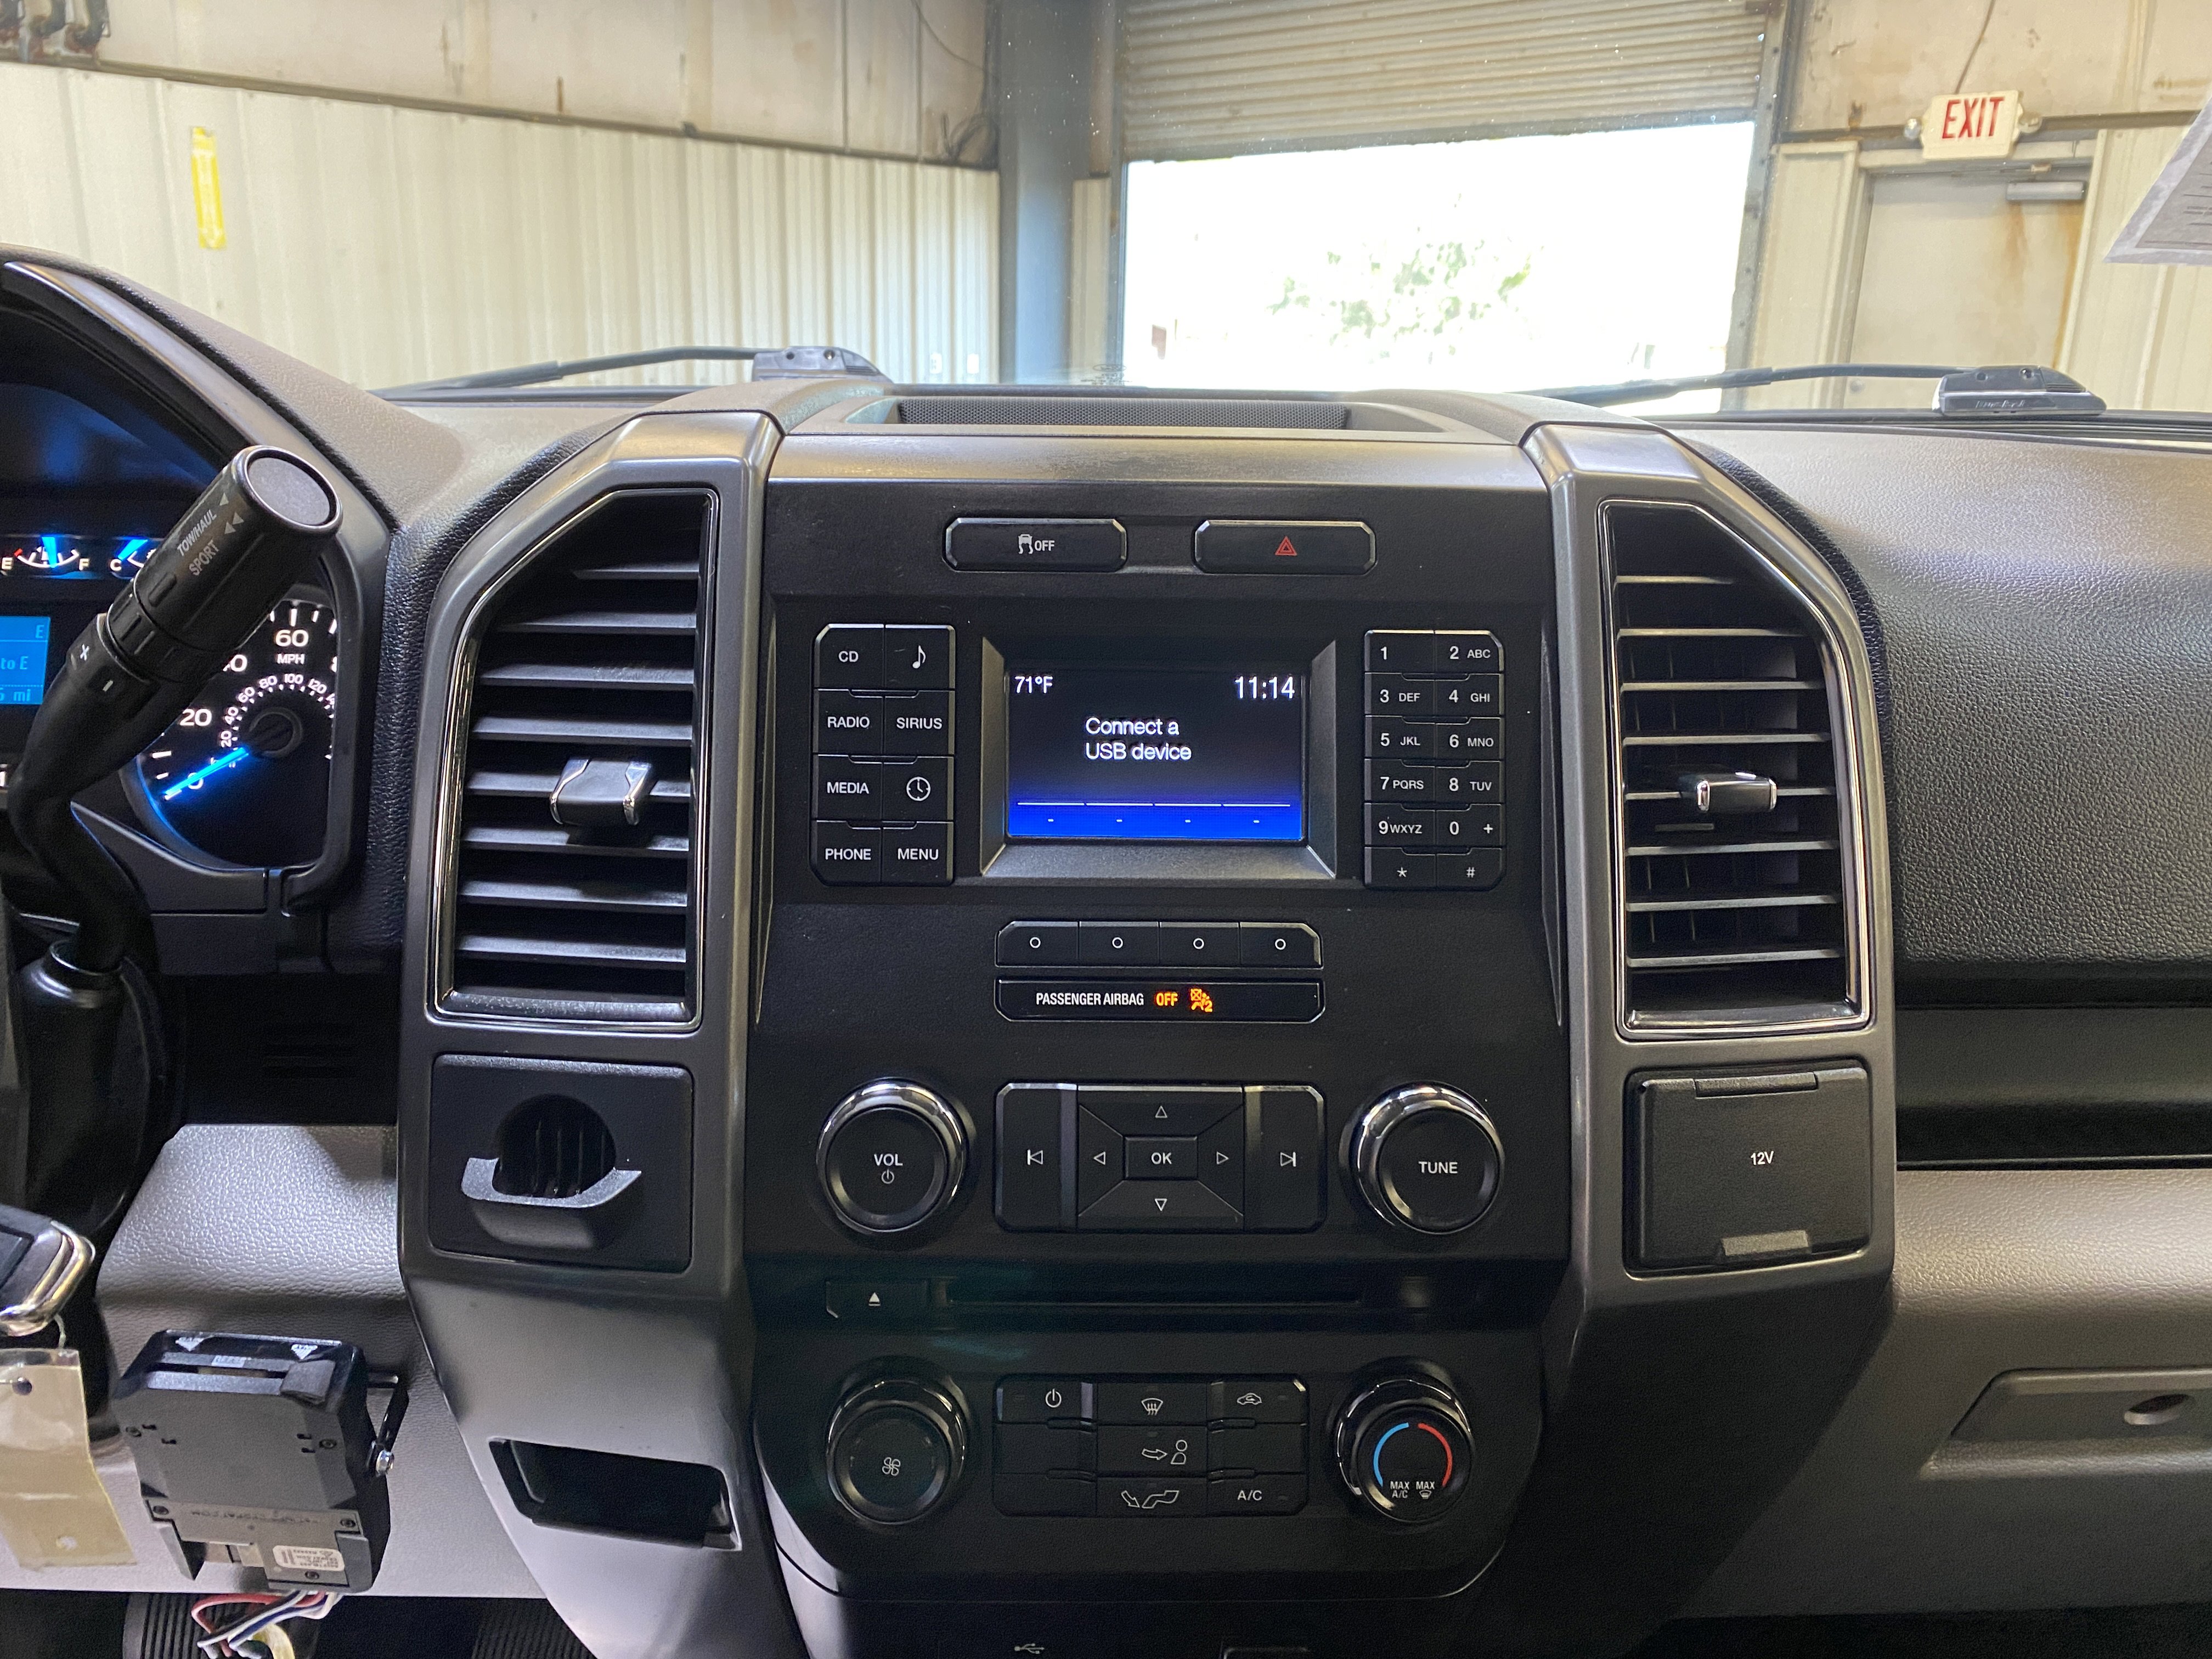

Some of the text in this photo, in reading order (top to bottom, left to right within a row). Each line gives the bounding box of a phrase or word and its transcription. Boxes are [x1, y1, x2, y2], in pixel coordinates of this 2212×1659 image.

[1942, 96, 2005, 139] EXIT
[1034, 540, 1055, 551] OFF
[1, 557, 13, 570] E
[189, 539, 219, 575] SPORT
[78, 558, 89, 571] F
[110, 558, 122, 571] C
[35, 624, 45, 638] E
[275, 629, 309, 647] 60
[277, 654, 305, 665] MPH
[838, 651, 859, 663] CD
[1380, 646, 1387, 660] 1
[1449, 646, 1491, 659] 2 ABC
[20, 656, 28, 669] E
[223, 654, 247, 672] 0
[258, 676, 278, 689] 80
[284, 674, 304, 685] 100
[1014, 675, 1053, 693] 71°F
[308, 679, 327, 695] 120
[1235, 676, 1295, 699] 11:14
[13, 689, 31, 701] mi
[238, 687, 256, 703] 60
[1380, 689, 1421, 703] 3 DEF
[1448, 689, 1490, 703] 4 GHI
[179, 708, 212, 726] 20
[224, 707, 239, 725] 40
[827, 716, 870, 728] RADIO
[896, 717, 943, 730] SIRIUS
[1085, 717, 1180, 735] Connect a
[221, 730, 232, 748] 20
[1380, 732, 1421, 747] 5 JKL
[1449, 734, 1494, 748] 6 MNO
[1086, 742, 1192, 760] USB device
[827, 782, 870, 794] MEDIA
[1380, 776, 1424, 790] 7 PQRS
[1449, 777, 1492, 792] 8 TUV
[1379, 820, 1423, 834] 9 WXYZ
[1449, 821, 1459, 835] 0
[825, 848, 871, 860] PHONE
[898, 848, 939, 860] MENU
[1036, 992, 1178, 1006] PASSENGER AIRBAG OFF
[874, 1153, 903, 1166] VOL
[1151, 1152, 1172, 1164] OK
[1751, 1150, 1774, 1165] 12V
[1418, 1161, 1458, 1174] TUNE
[1390, 1481, 1410, 1490] MAX
[1416, 1481, 1435, 1490] MAX
[1237, 1489, 1262, 1501] A/C
[1392, 1489, 1408, 1498] A/C
